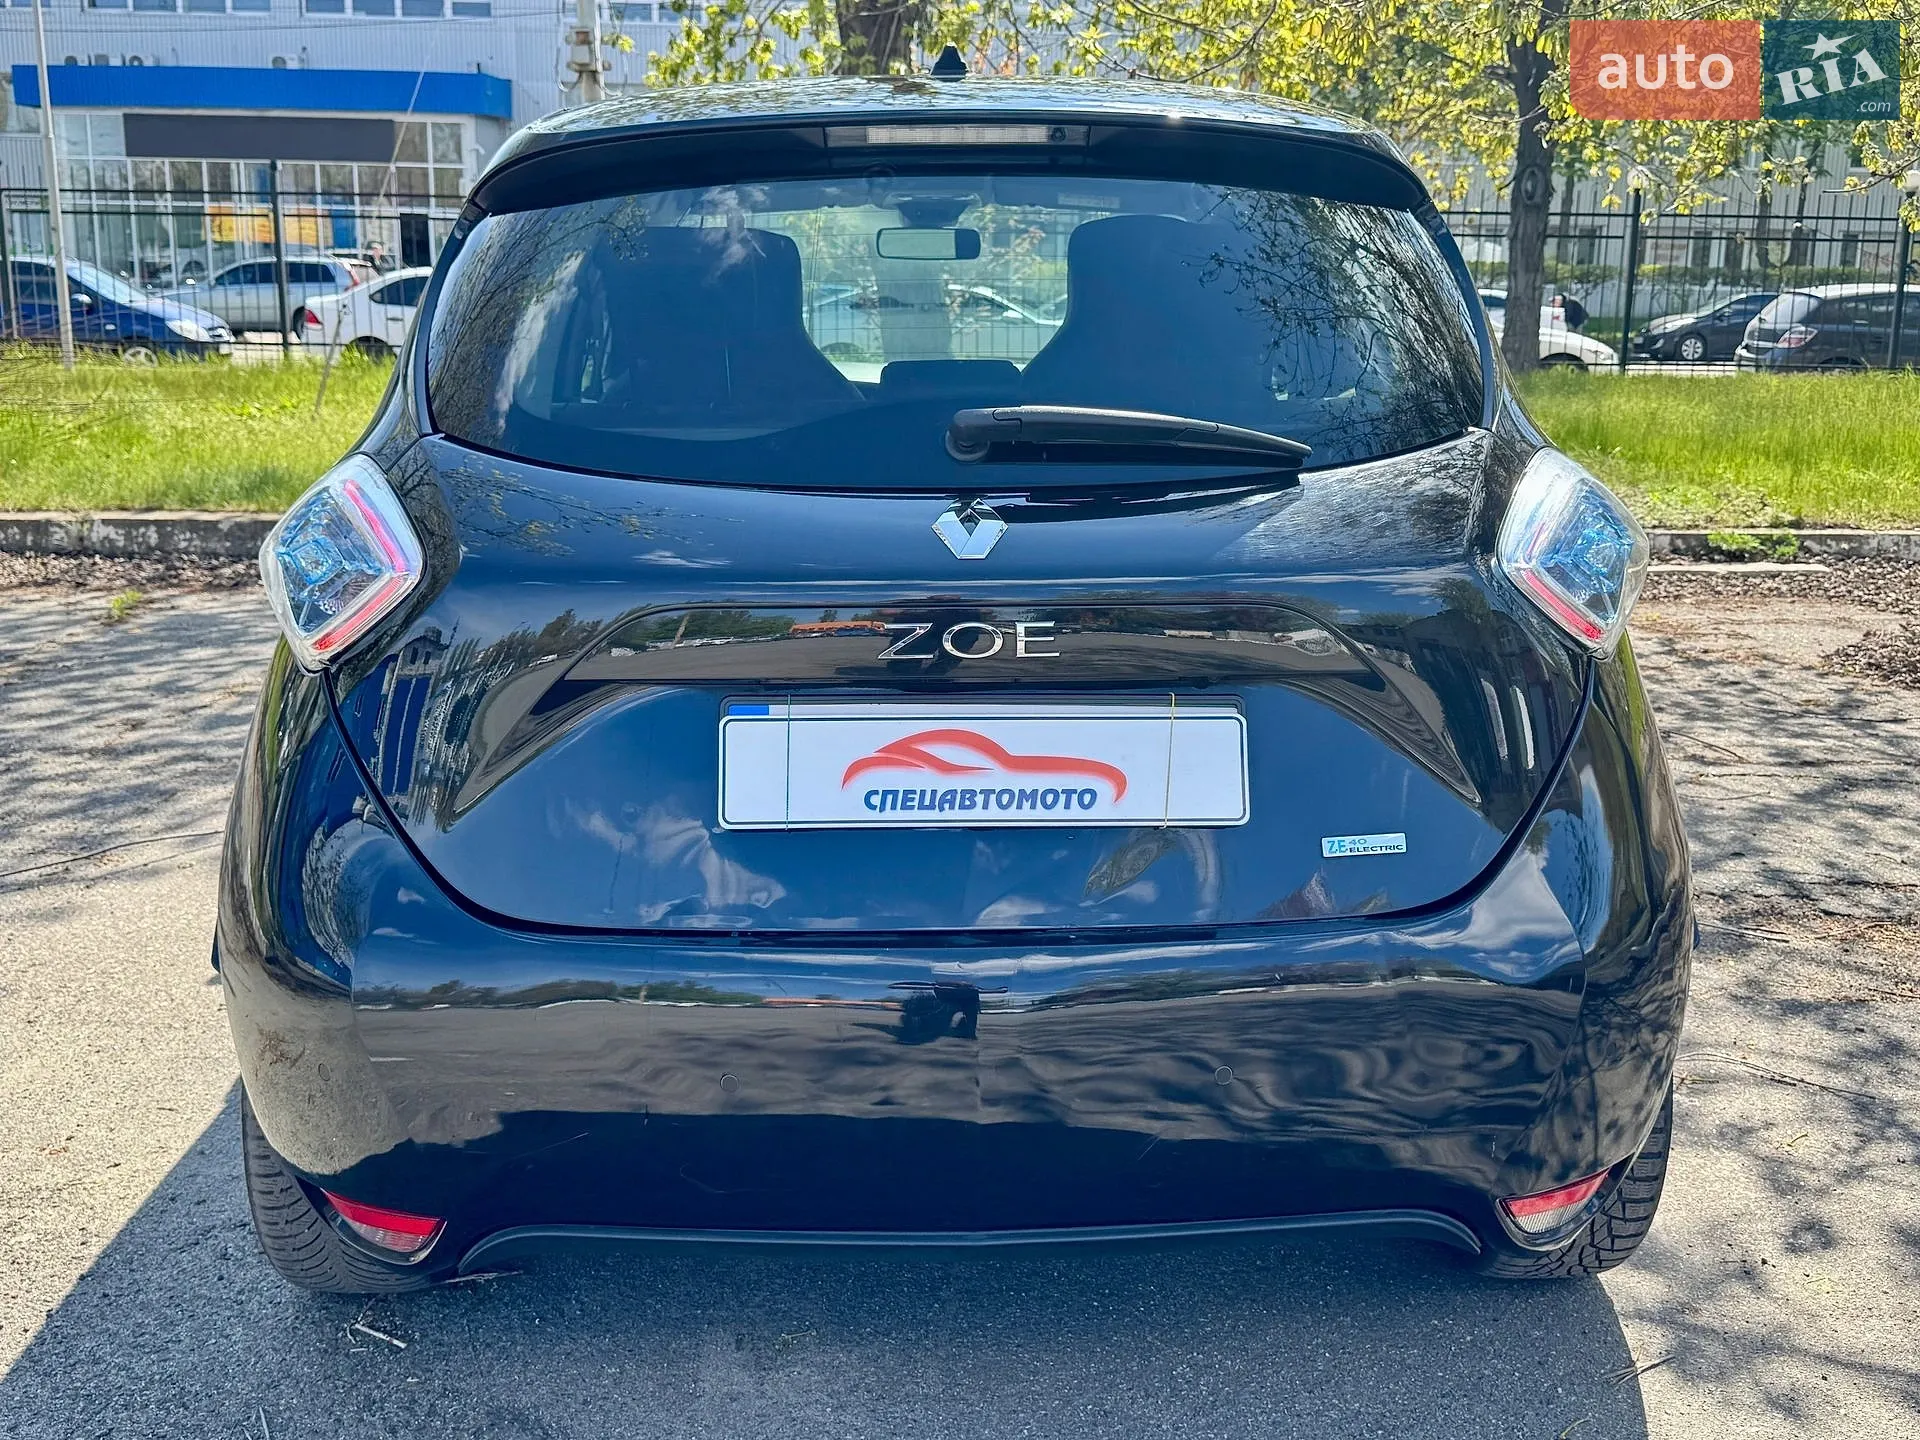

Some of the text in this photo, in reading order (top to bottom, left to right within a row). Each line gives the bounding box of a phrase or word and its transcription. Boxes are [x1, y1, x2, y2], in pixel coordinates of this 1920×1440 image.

[878, 621, 1061, 659] ZOE
[864, 788, 1097, 812] СПЕЦАВТОМОТО
[1349, 844, 1404, 853] ELECTRIC
